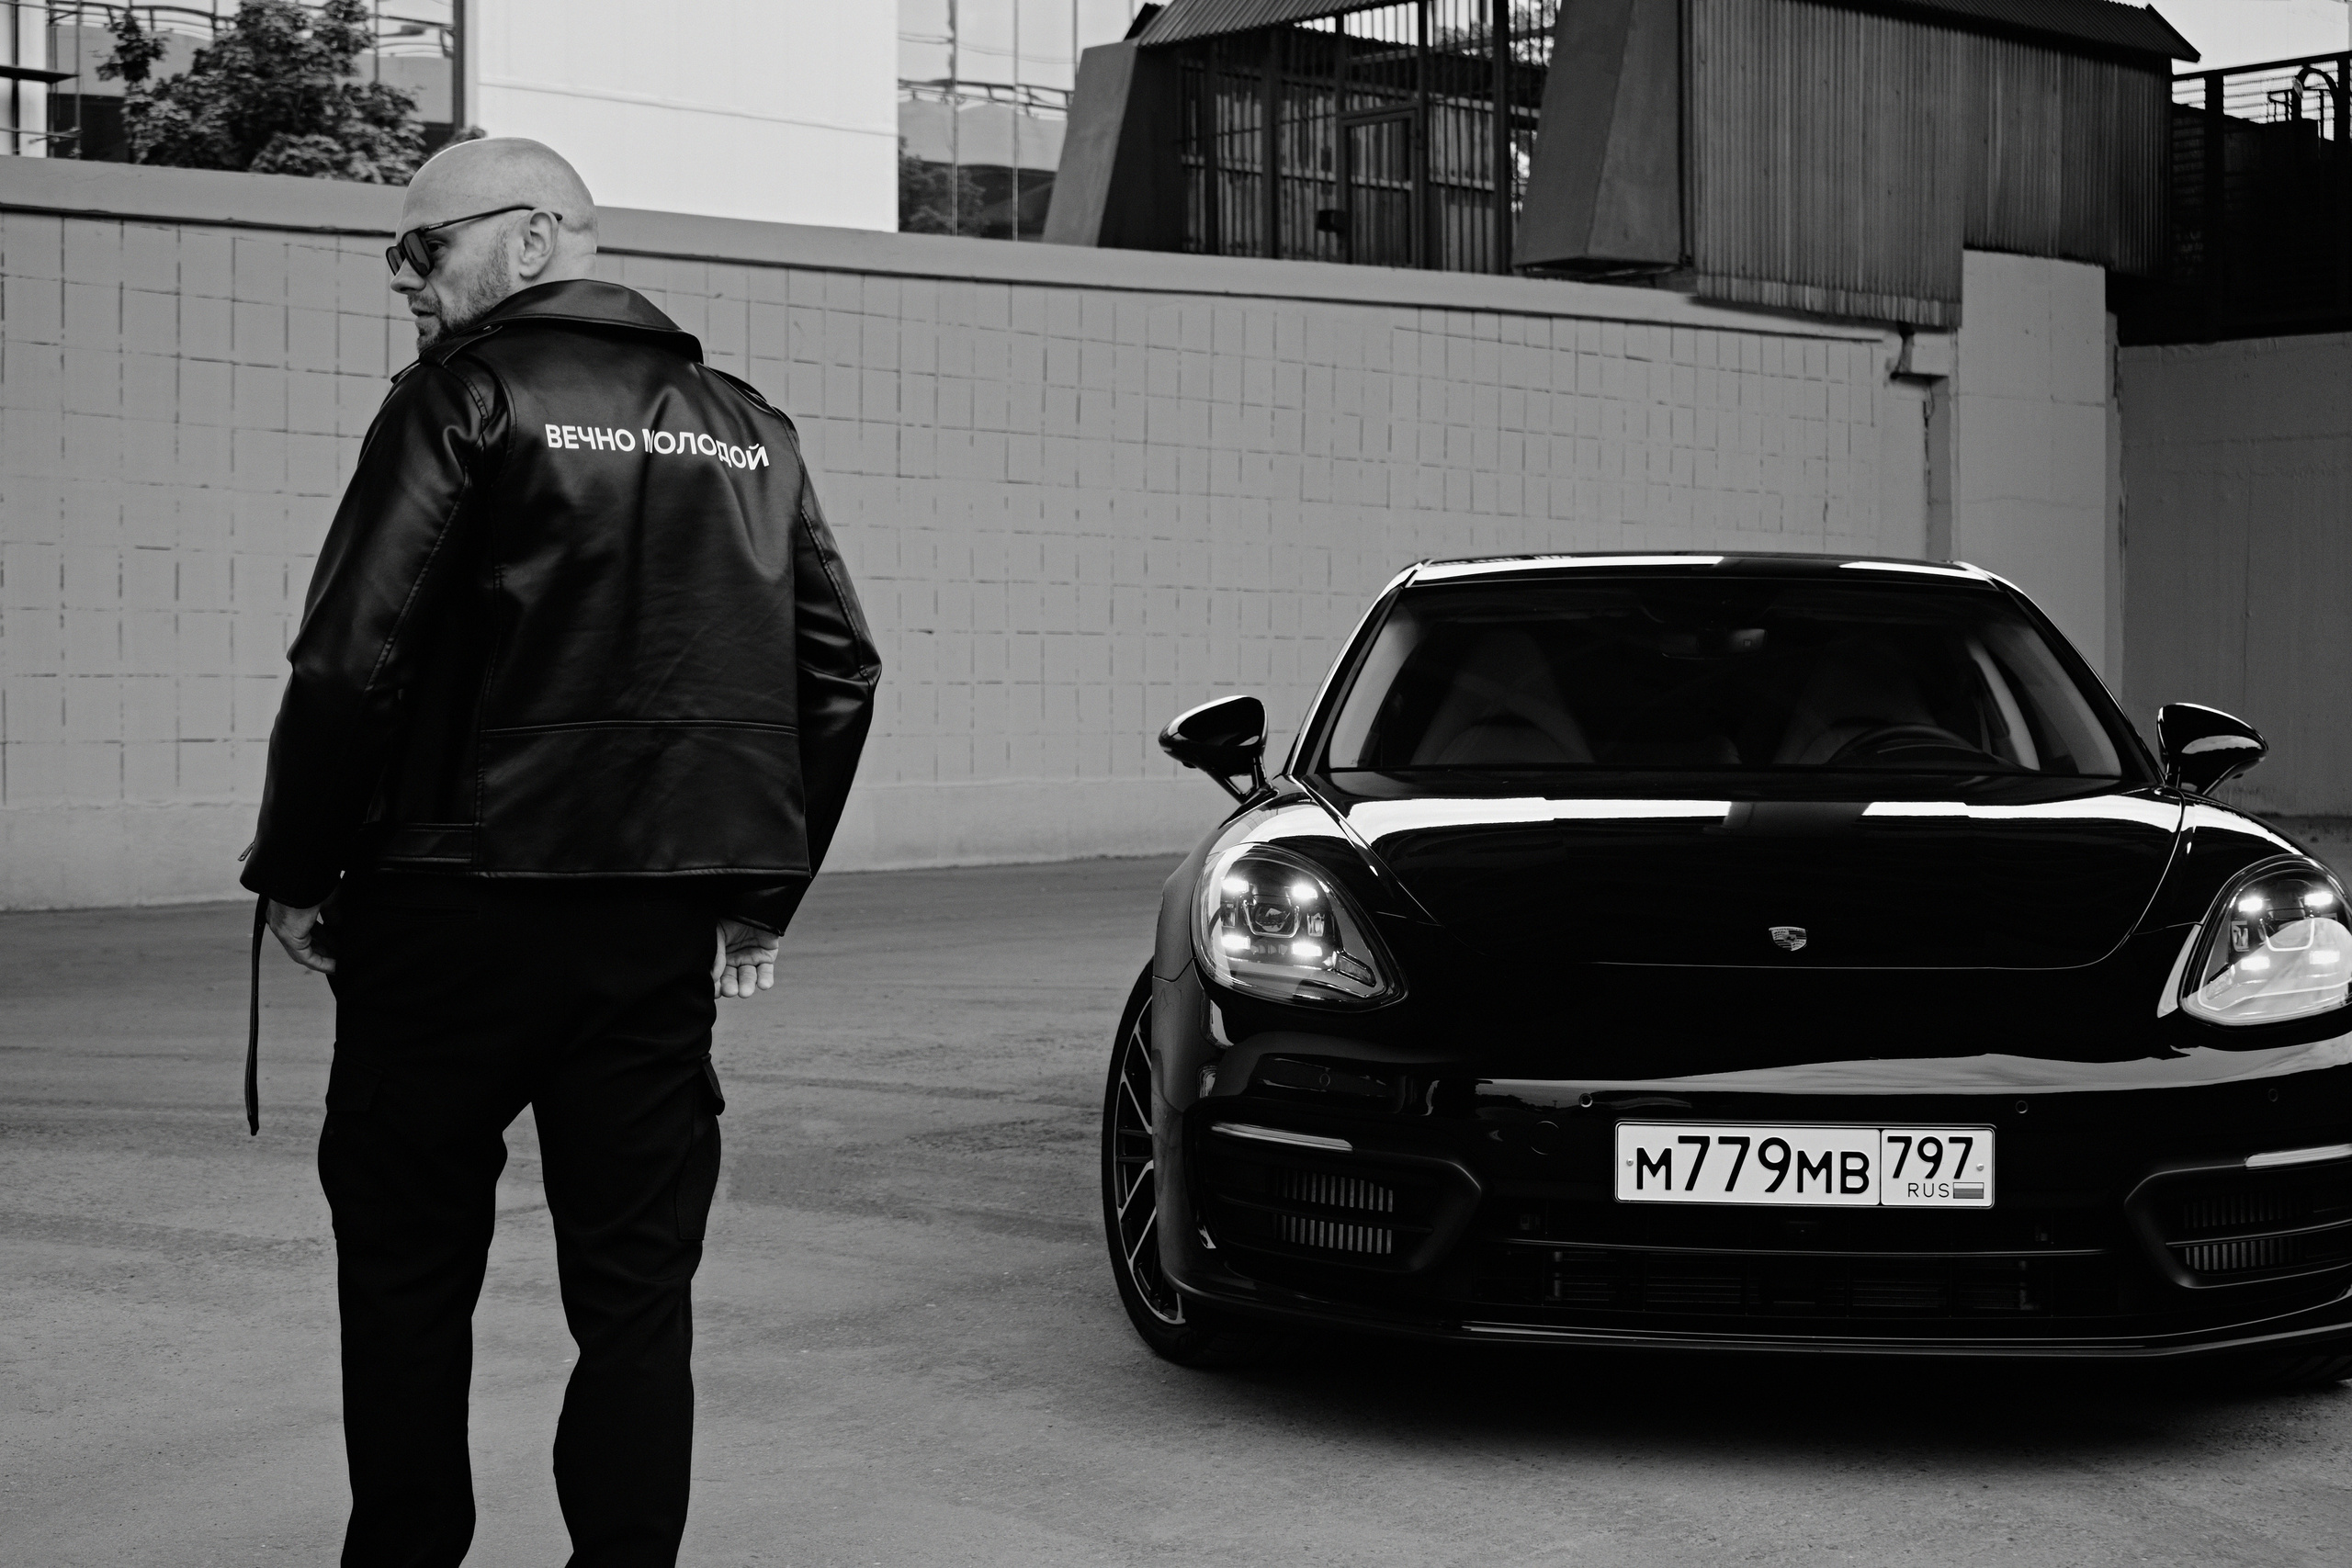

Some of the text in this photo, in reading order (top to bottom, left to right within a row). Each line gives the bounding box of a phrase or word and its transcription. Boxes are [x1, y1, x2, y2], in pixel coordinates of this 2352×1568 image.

[545, 423, 636, 452] ВЕЧНО
[1886, 1135, 1974, 1180] 797
[1907, 1182, 1950, 1199] RUS
